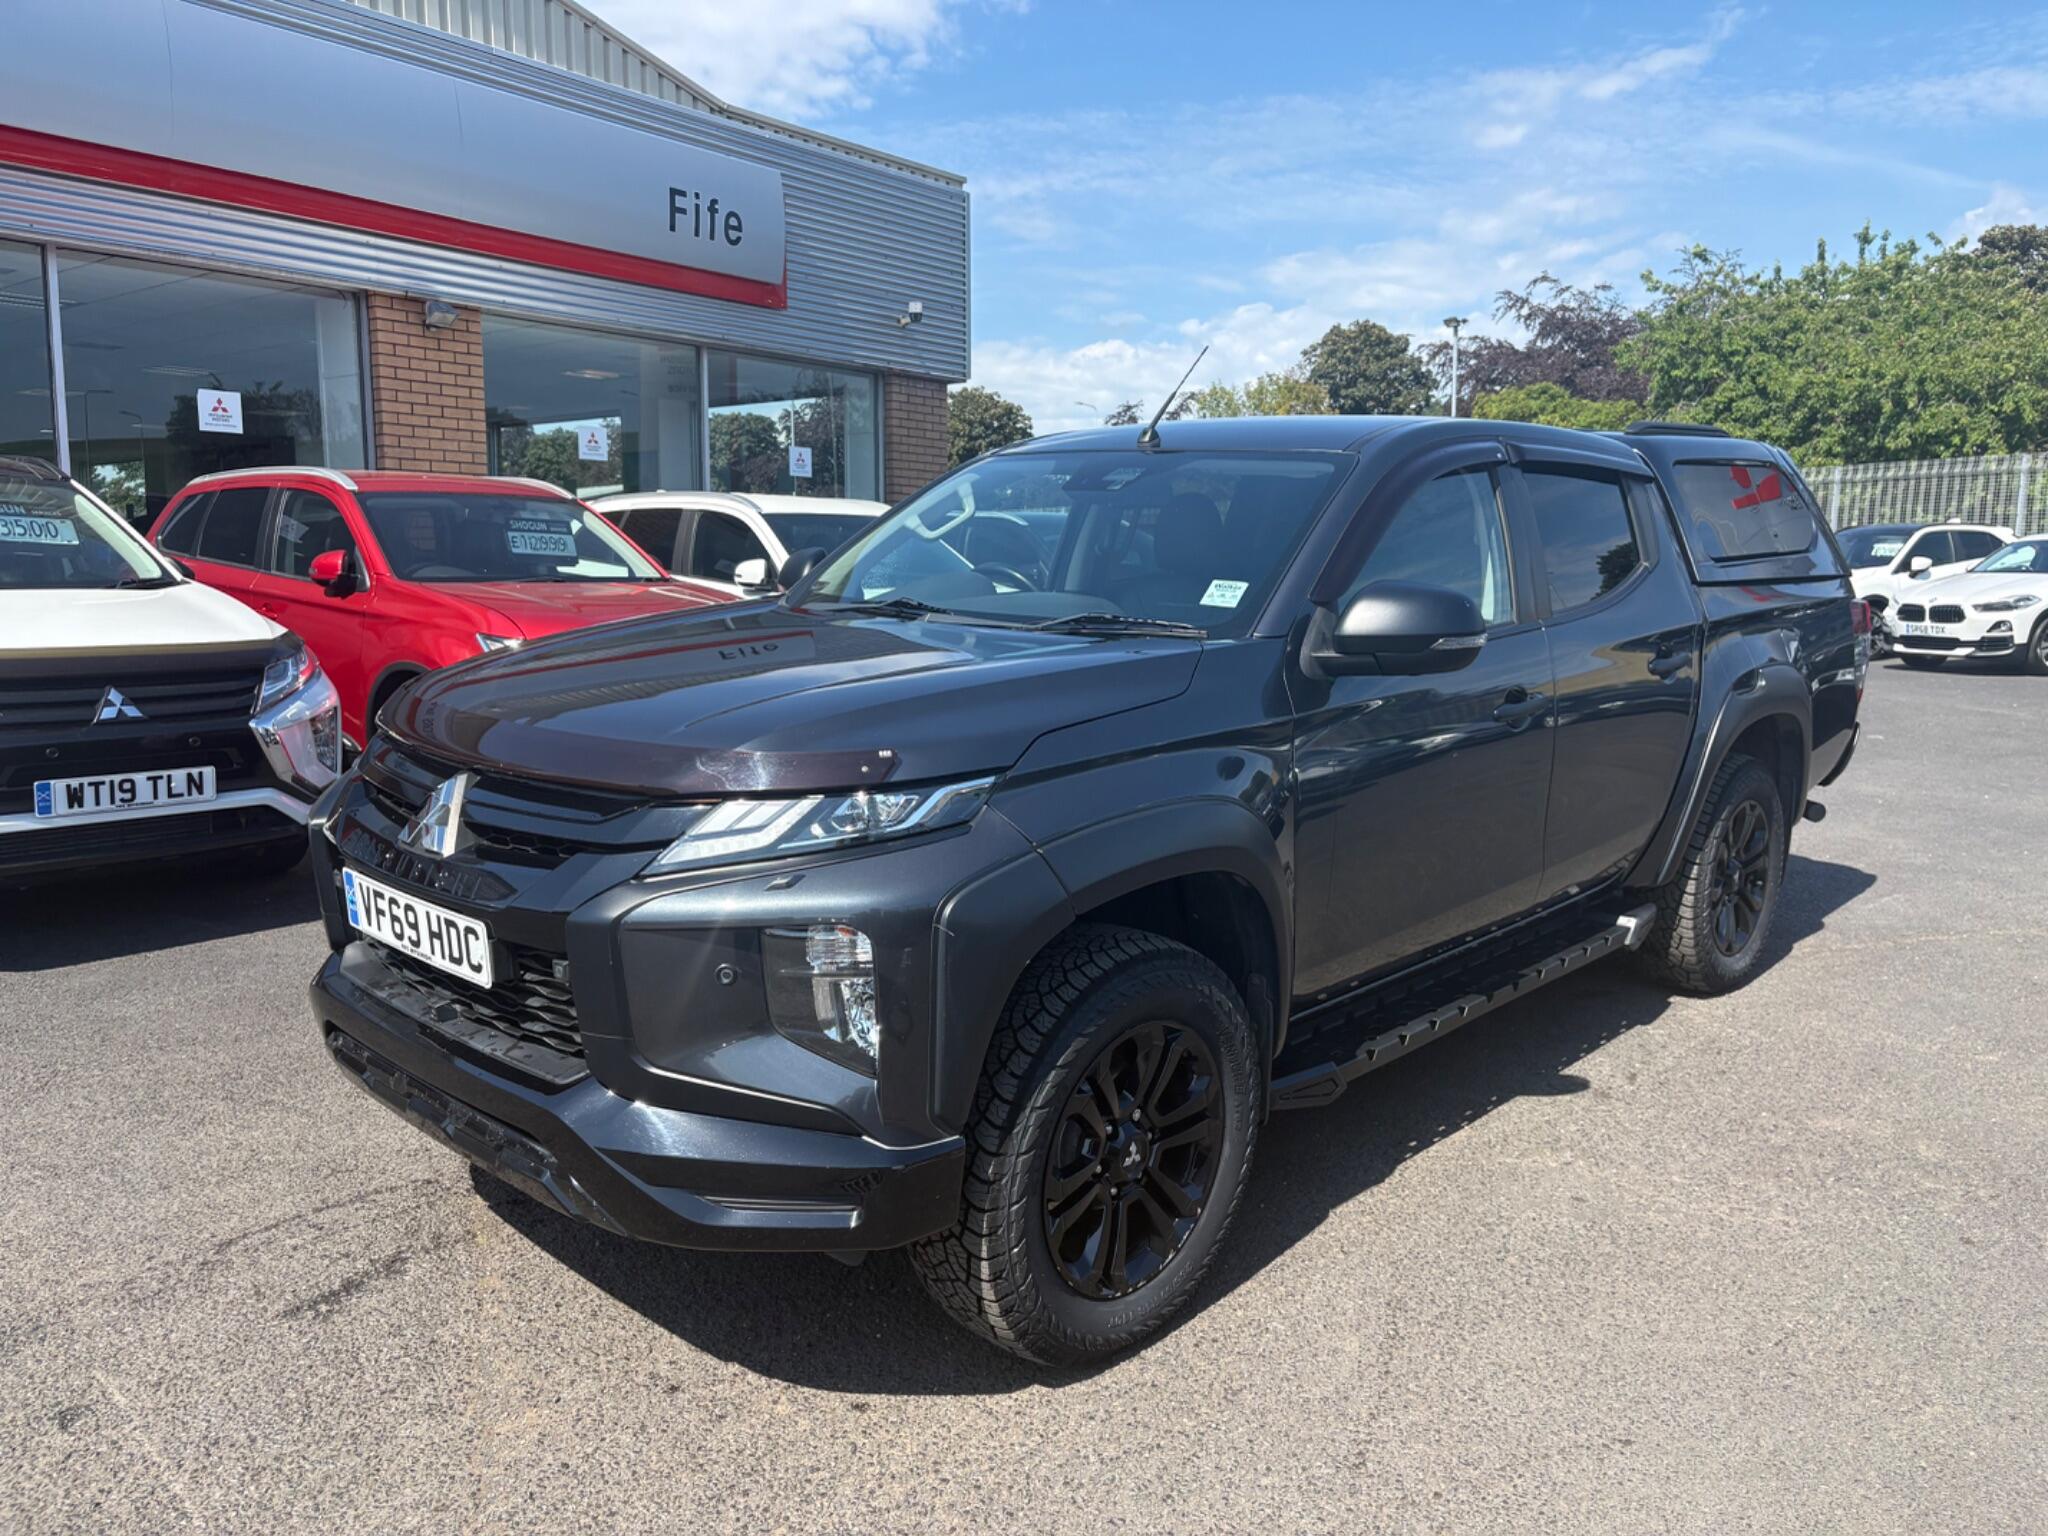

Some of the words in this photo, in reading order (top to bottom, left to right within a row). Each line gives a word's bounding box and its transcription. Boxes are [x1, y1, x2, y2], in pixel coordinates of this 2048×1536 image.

[668, 186, 743, 247] Fife
[65, 777, 137, 810] WT19
[146, 770, 205, 801] TLN
[358, 881, 421, 950] VF69
[425, 910, 484, 975] HDC
